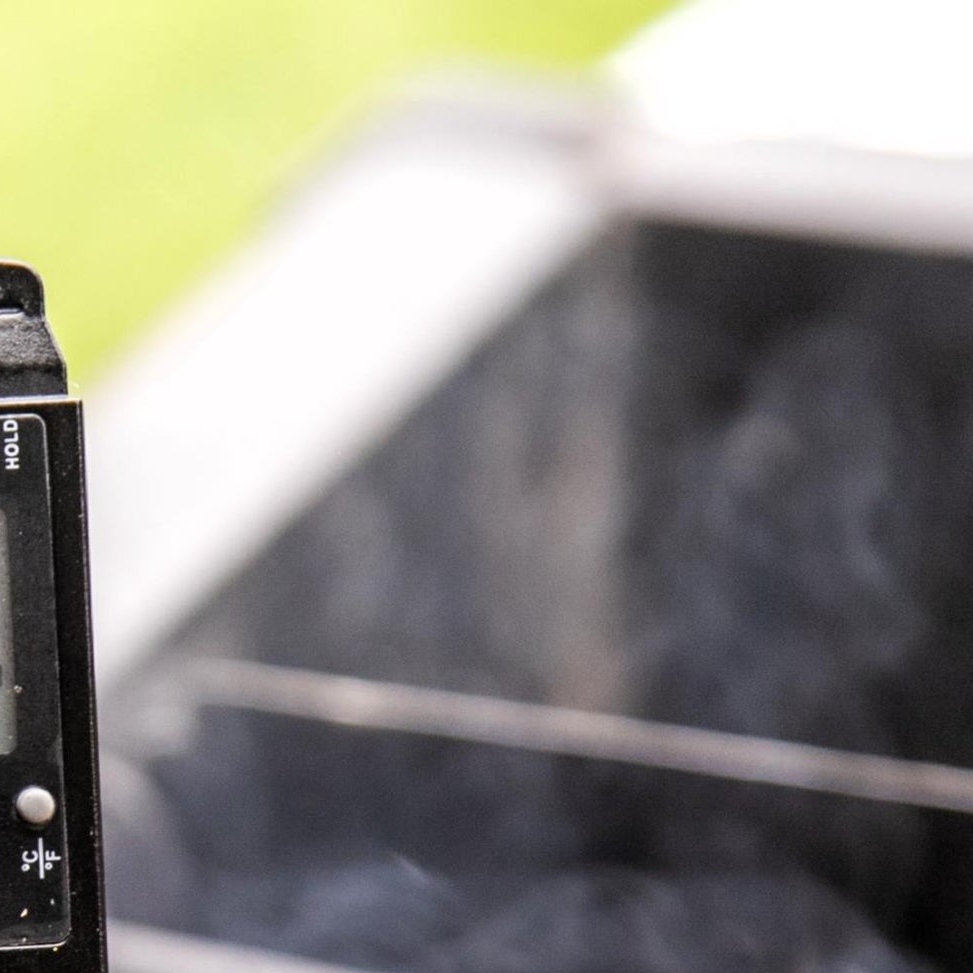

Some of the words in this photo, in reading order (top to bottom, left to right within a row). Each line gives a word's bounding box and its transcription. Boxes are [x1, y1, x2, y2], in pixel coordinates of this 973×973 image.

[4, 418, 20, 471] HOLD
[21, 850, 39, 872] °C
[44, 850, 62, 870] °F
